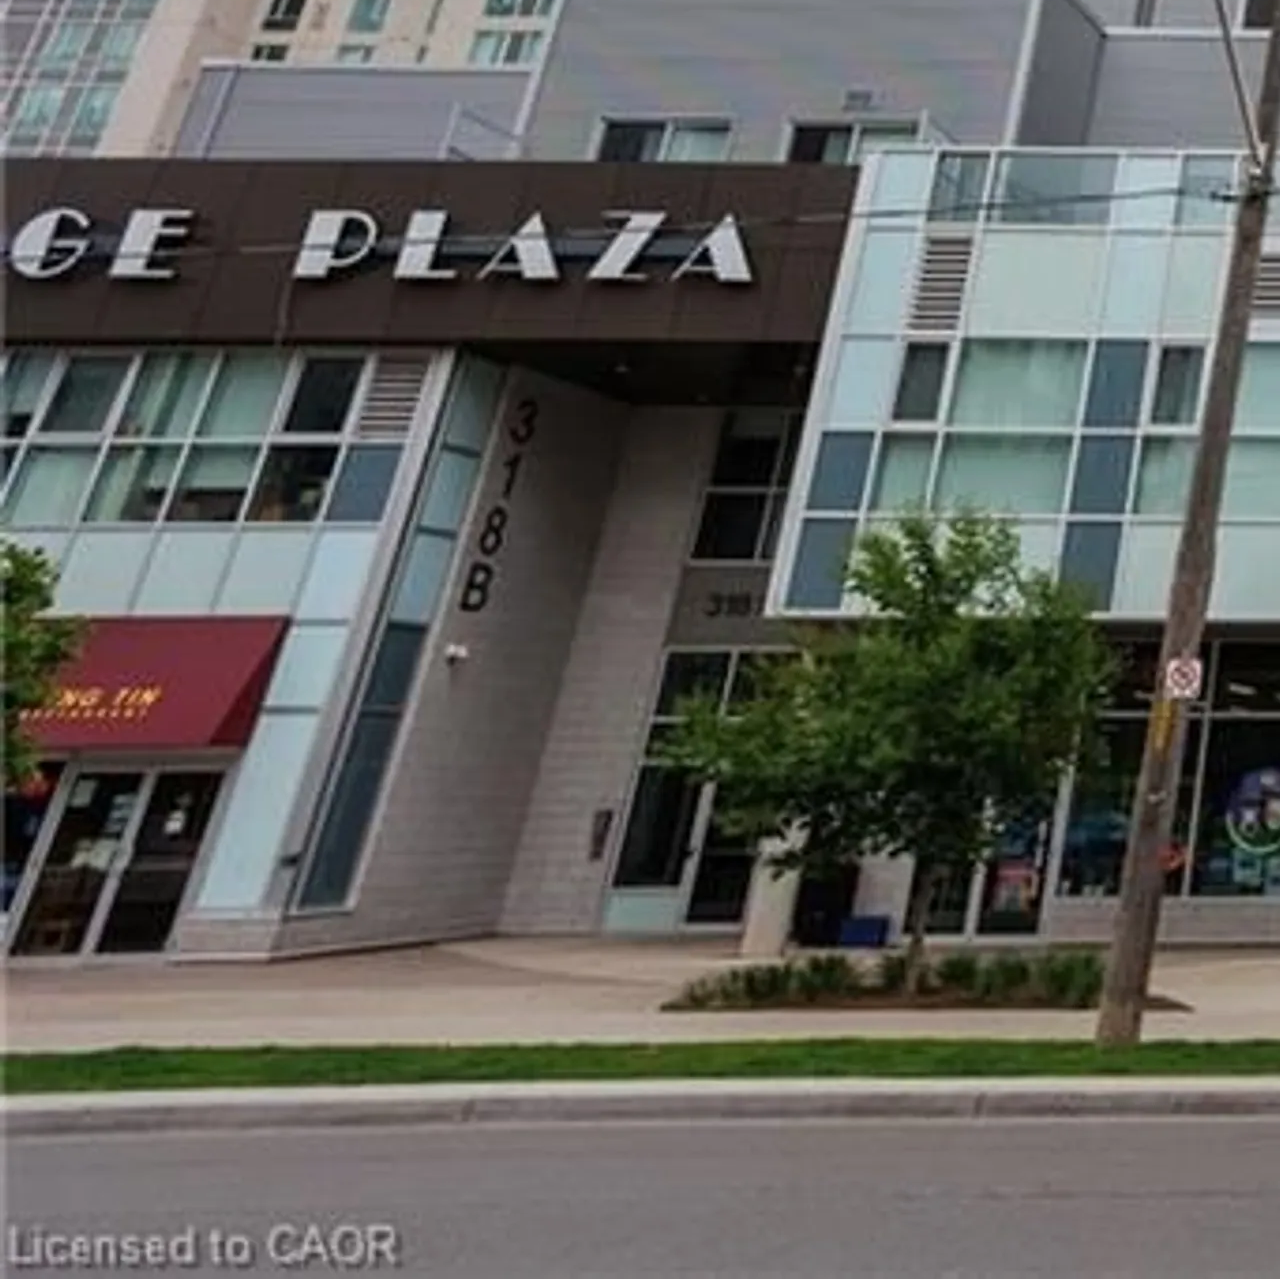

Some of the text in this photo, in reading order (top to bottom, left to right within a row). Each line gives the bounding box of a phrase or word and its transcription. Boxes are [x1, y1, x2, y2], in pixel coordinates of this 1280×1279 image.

[11, 206, 754, 282] GE PLAZA
[460, 399, 540, 612] 318B
[50, 686, 103, 707] NG
